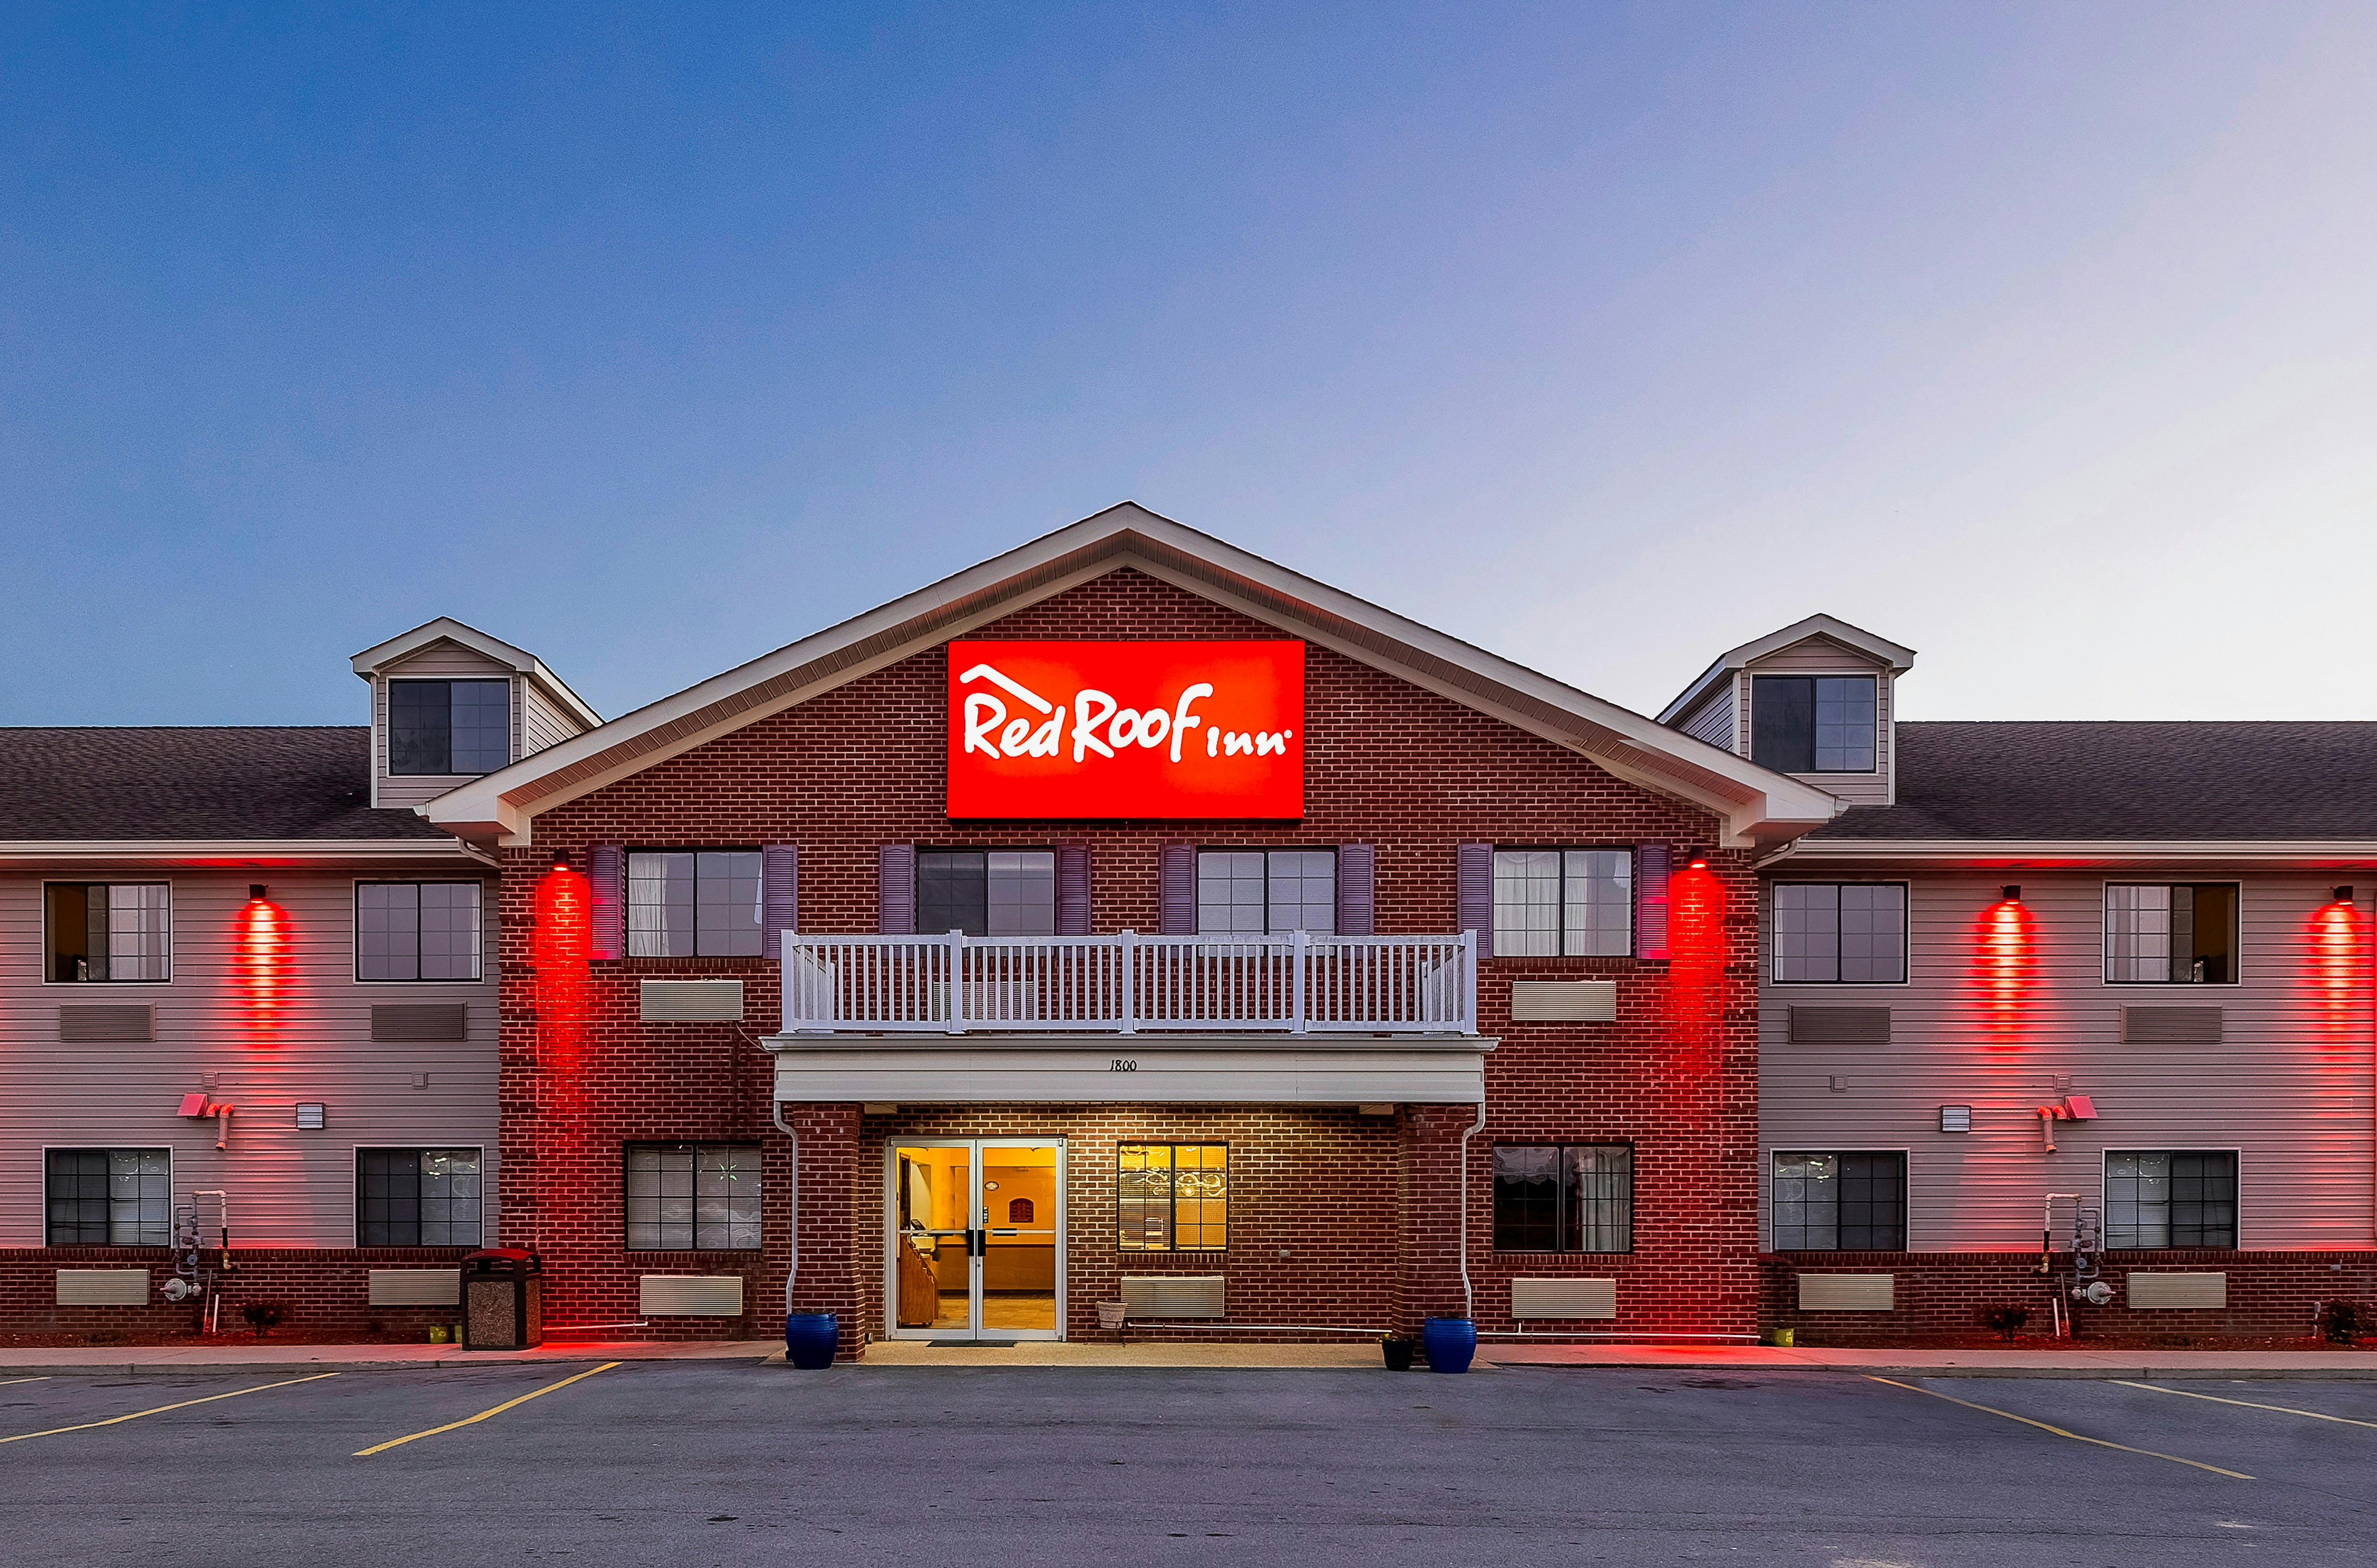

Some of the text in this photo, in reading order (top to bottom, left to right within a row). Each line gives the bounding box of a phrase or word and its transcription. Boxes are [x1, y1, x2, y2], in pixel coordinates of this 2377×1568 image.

[964, 692, 1066, 759] Red
[1071, 683, 1213, 763] Roof
[1110, 1059, 1137, 1071] 1800
